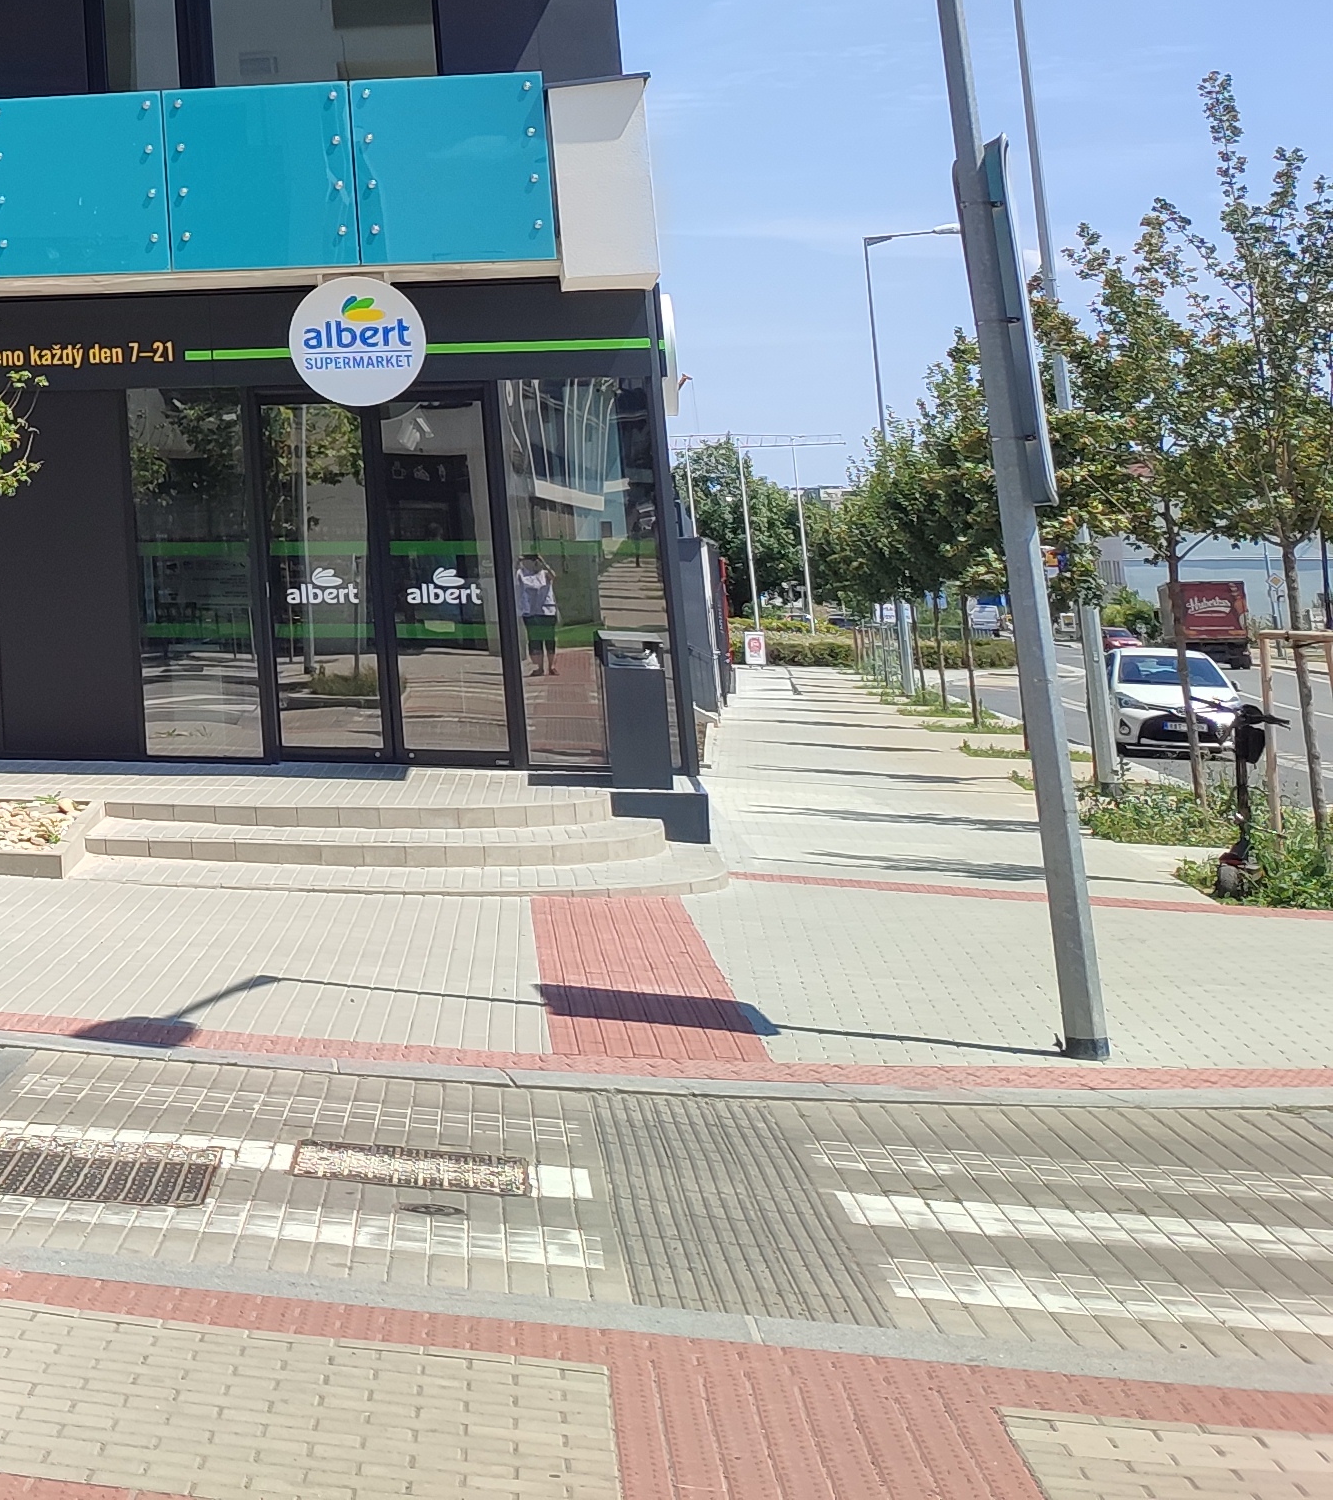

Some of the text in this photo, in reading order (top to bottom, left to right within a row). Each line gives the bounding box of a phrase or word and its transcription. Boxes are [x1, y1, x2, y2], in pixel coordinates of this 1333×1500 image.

[303, 318, 412, 349] albert
[30, 344, 83, 369] každý
[89, 343, 123, 364] den
[304, 354, 413, 370] SUPERMARKET
[286, 583, 360, 604] albert
[406, 583, 483, 604] albert
